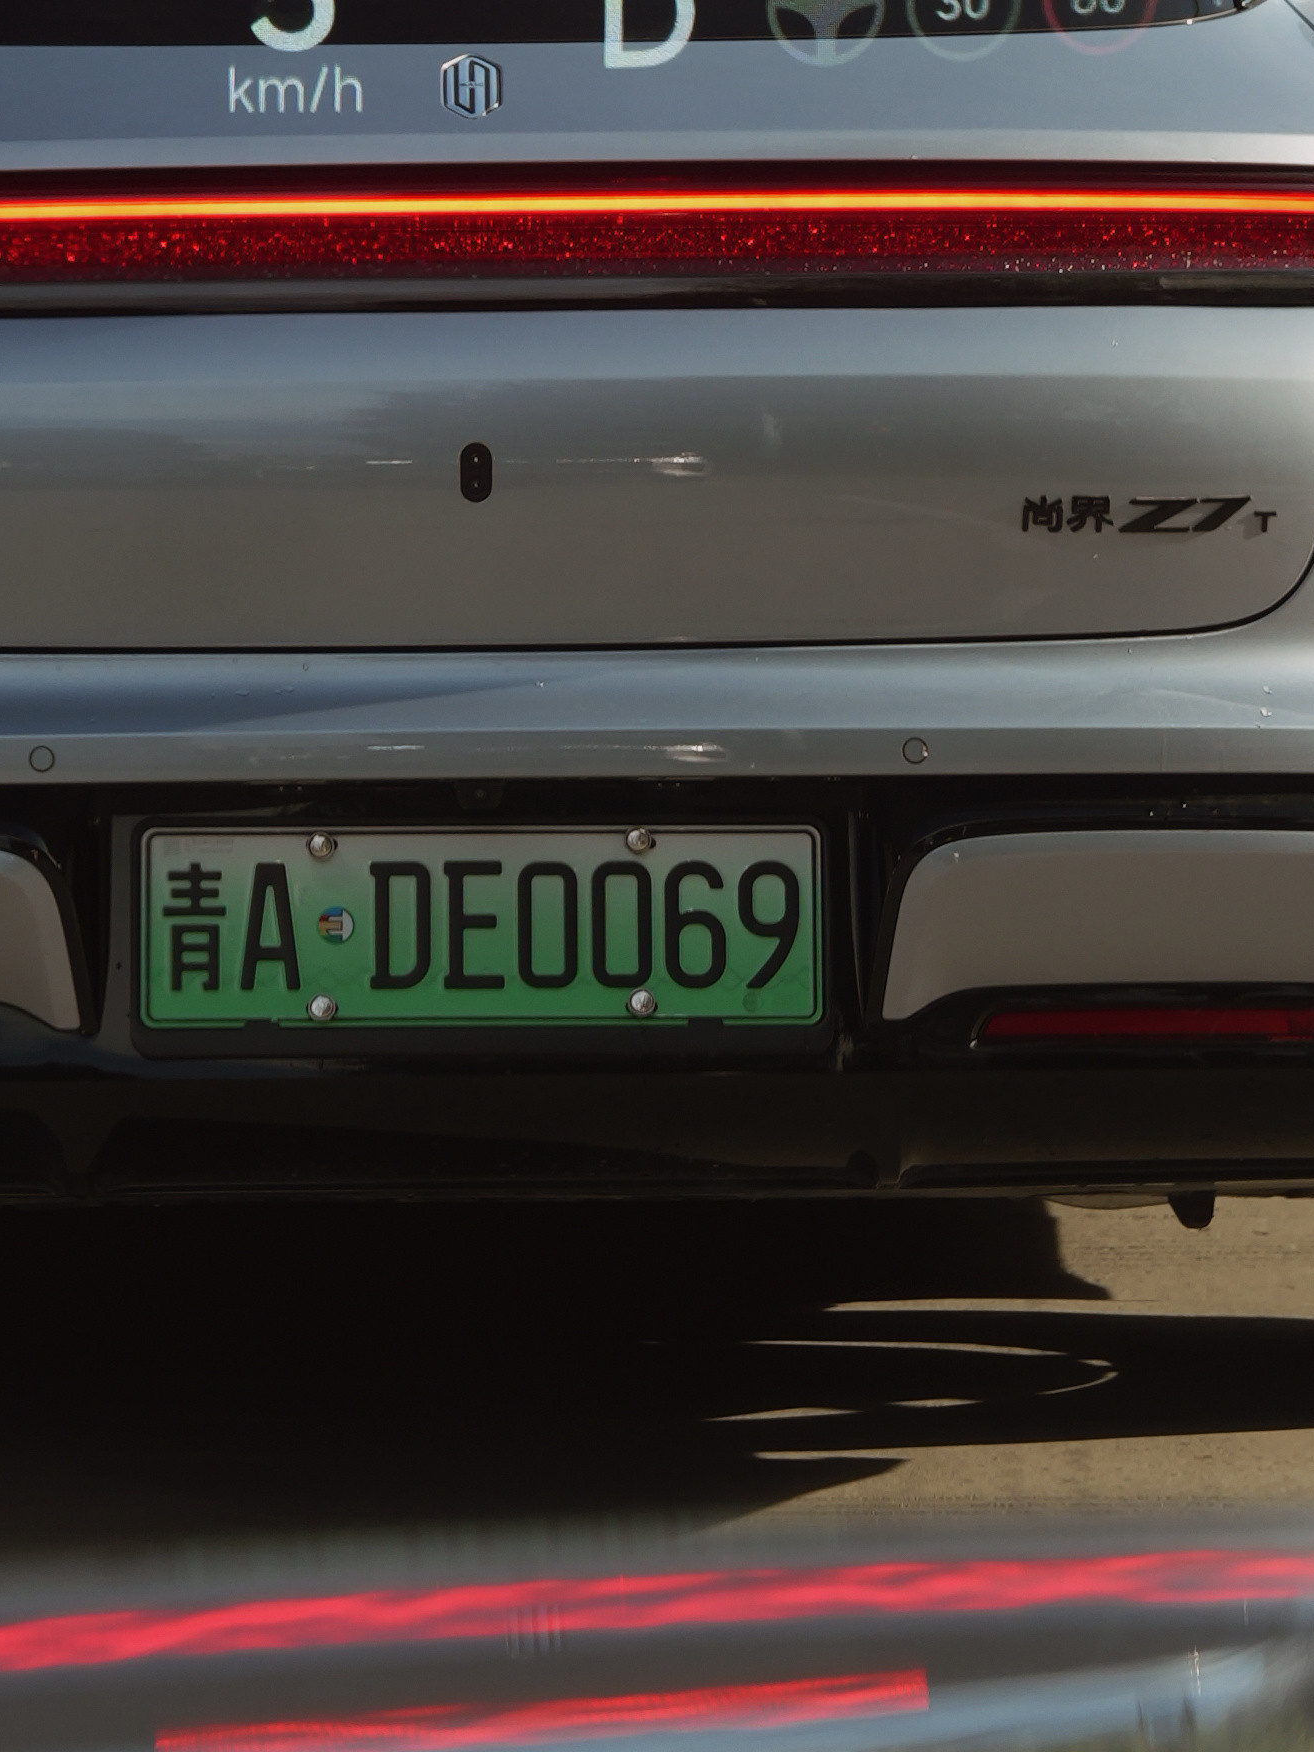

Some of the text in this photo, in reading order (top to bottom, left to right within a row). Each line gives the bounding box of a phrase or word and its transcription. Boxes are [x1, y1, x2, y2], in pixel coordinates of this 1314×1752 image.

[227, 64, 364, 115] km/h
[1021, 494, 1115, 533] 尚界
[162, 860, 802, 993] 青A DE0069
